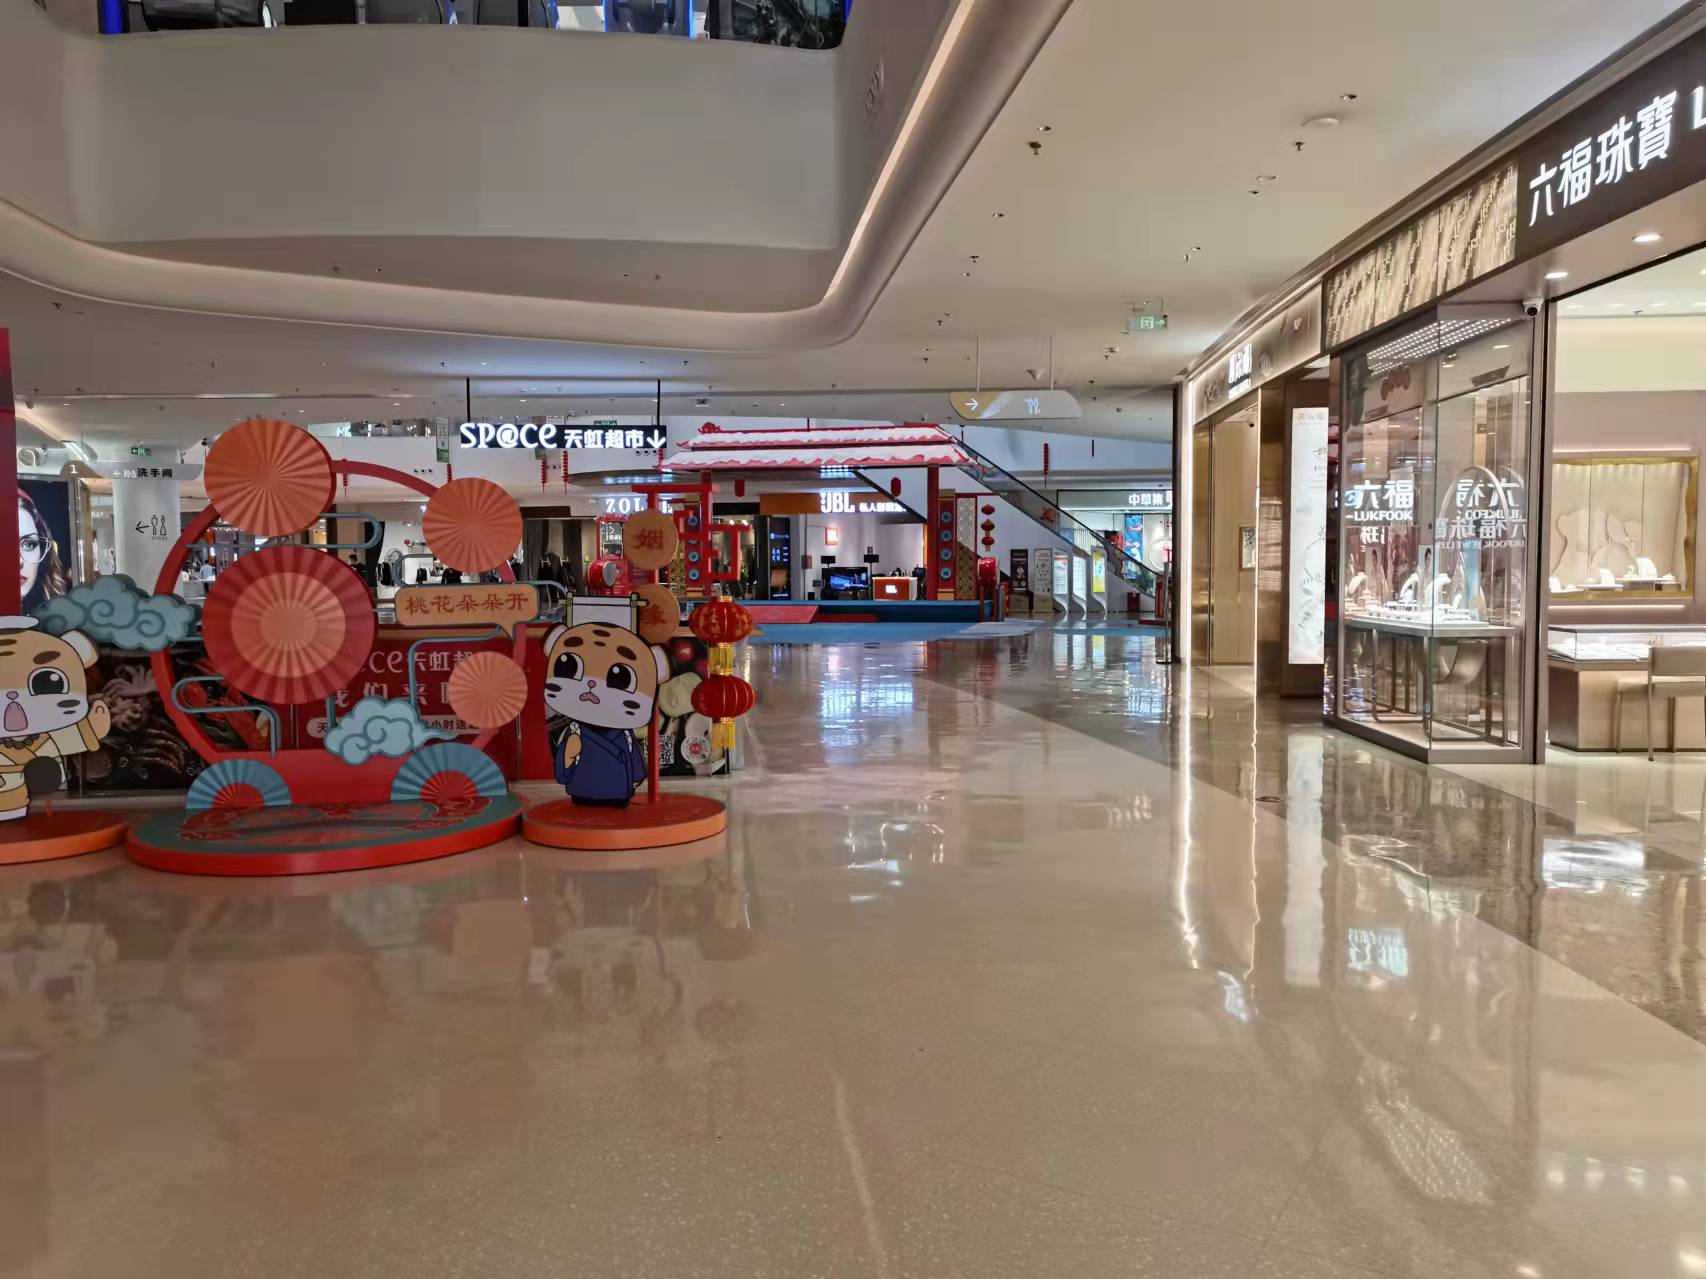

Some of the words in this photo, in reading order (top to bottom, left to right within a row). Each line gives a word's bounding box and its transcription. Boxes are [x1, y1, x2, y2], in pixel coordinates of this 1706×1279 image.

[1528, 90, 1678, 227] 六福珠寶
[564, 430, 645, 448] 天虹超市
[69, 464, 78, 474] 1
[137, 467, 173, 478] 洗手间
[1353, 479, 1414, 509] 六福
[1354, 510, 1414, 521] LUKFOOK
[405, 592, 529, 616] 桃花朵朵开
